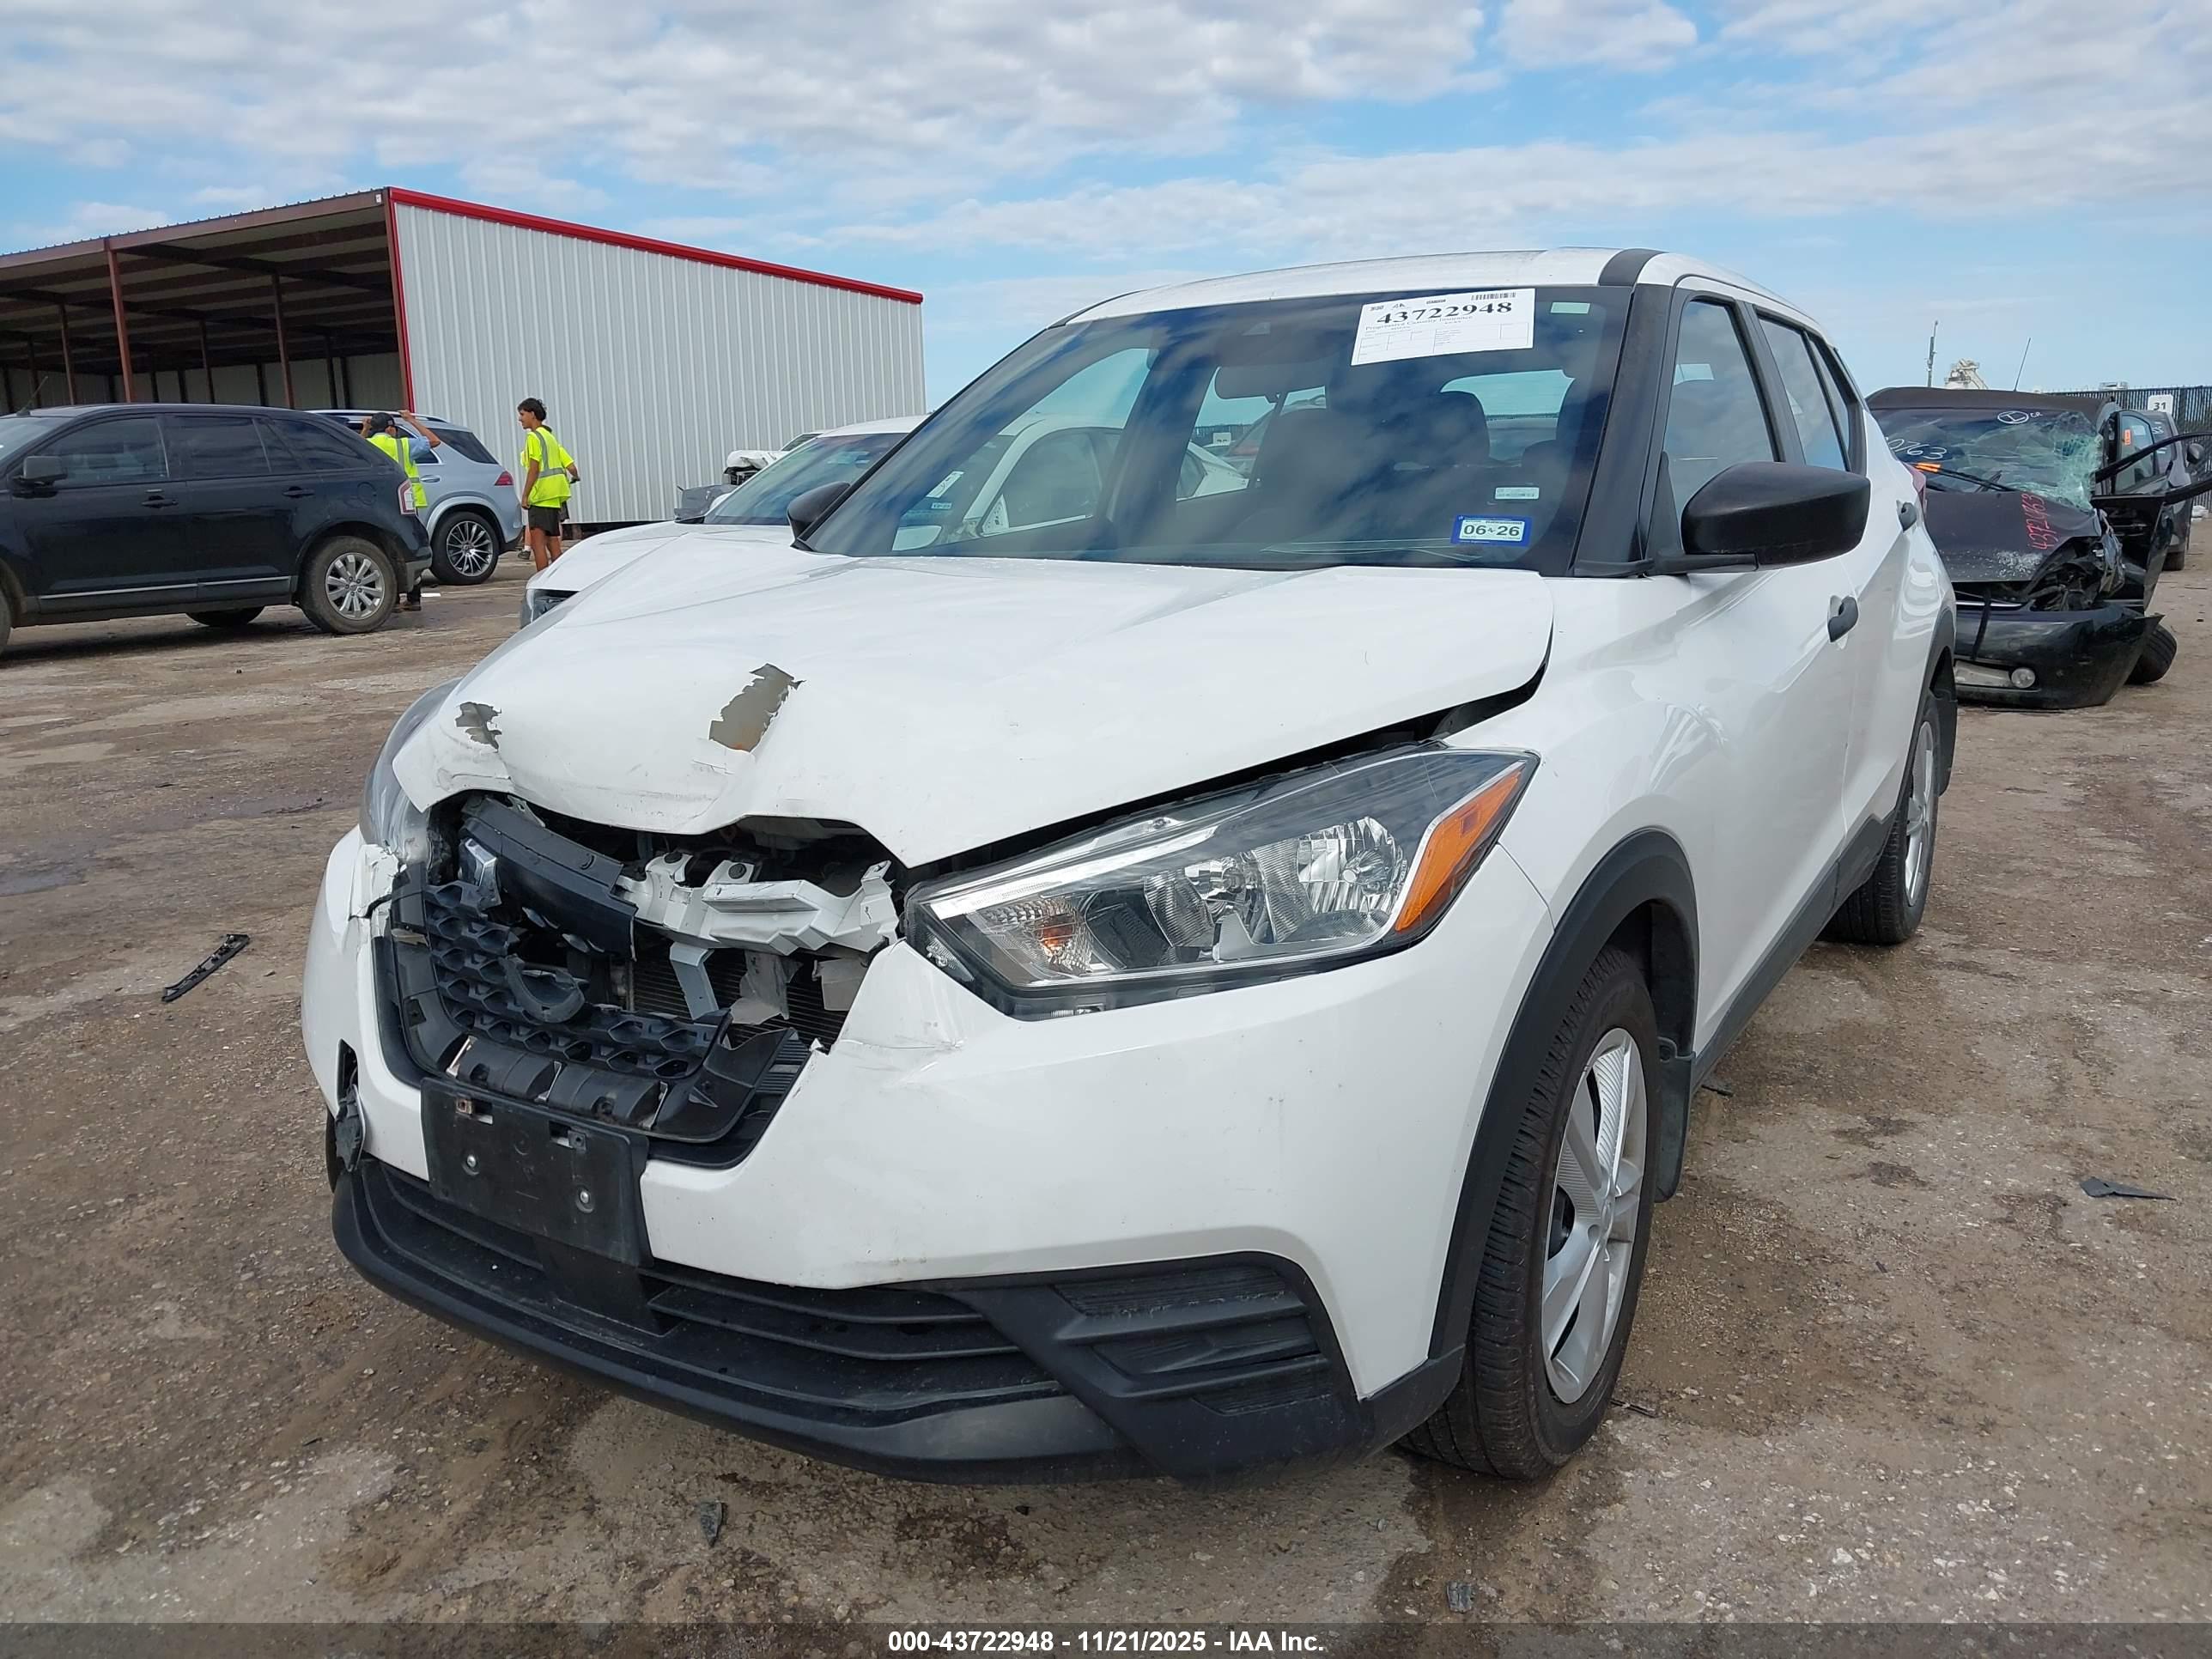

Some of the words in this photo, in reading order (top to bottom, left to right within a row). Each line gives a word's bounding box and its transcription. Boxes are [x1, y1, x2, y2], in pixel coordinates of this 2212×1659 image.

[1376, 301, 1512, 324] 43722948
[2154, 402, 2166, 410] 31
[1463, 525, 1486, 535] 06
[1496, 526, 1520, 536] 26
